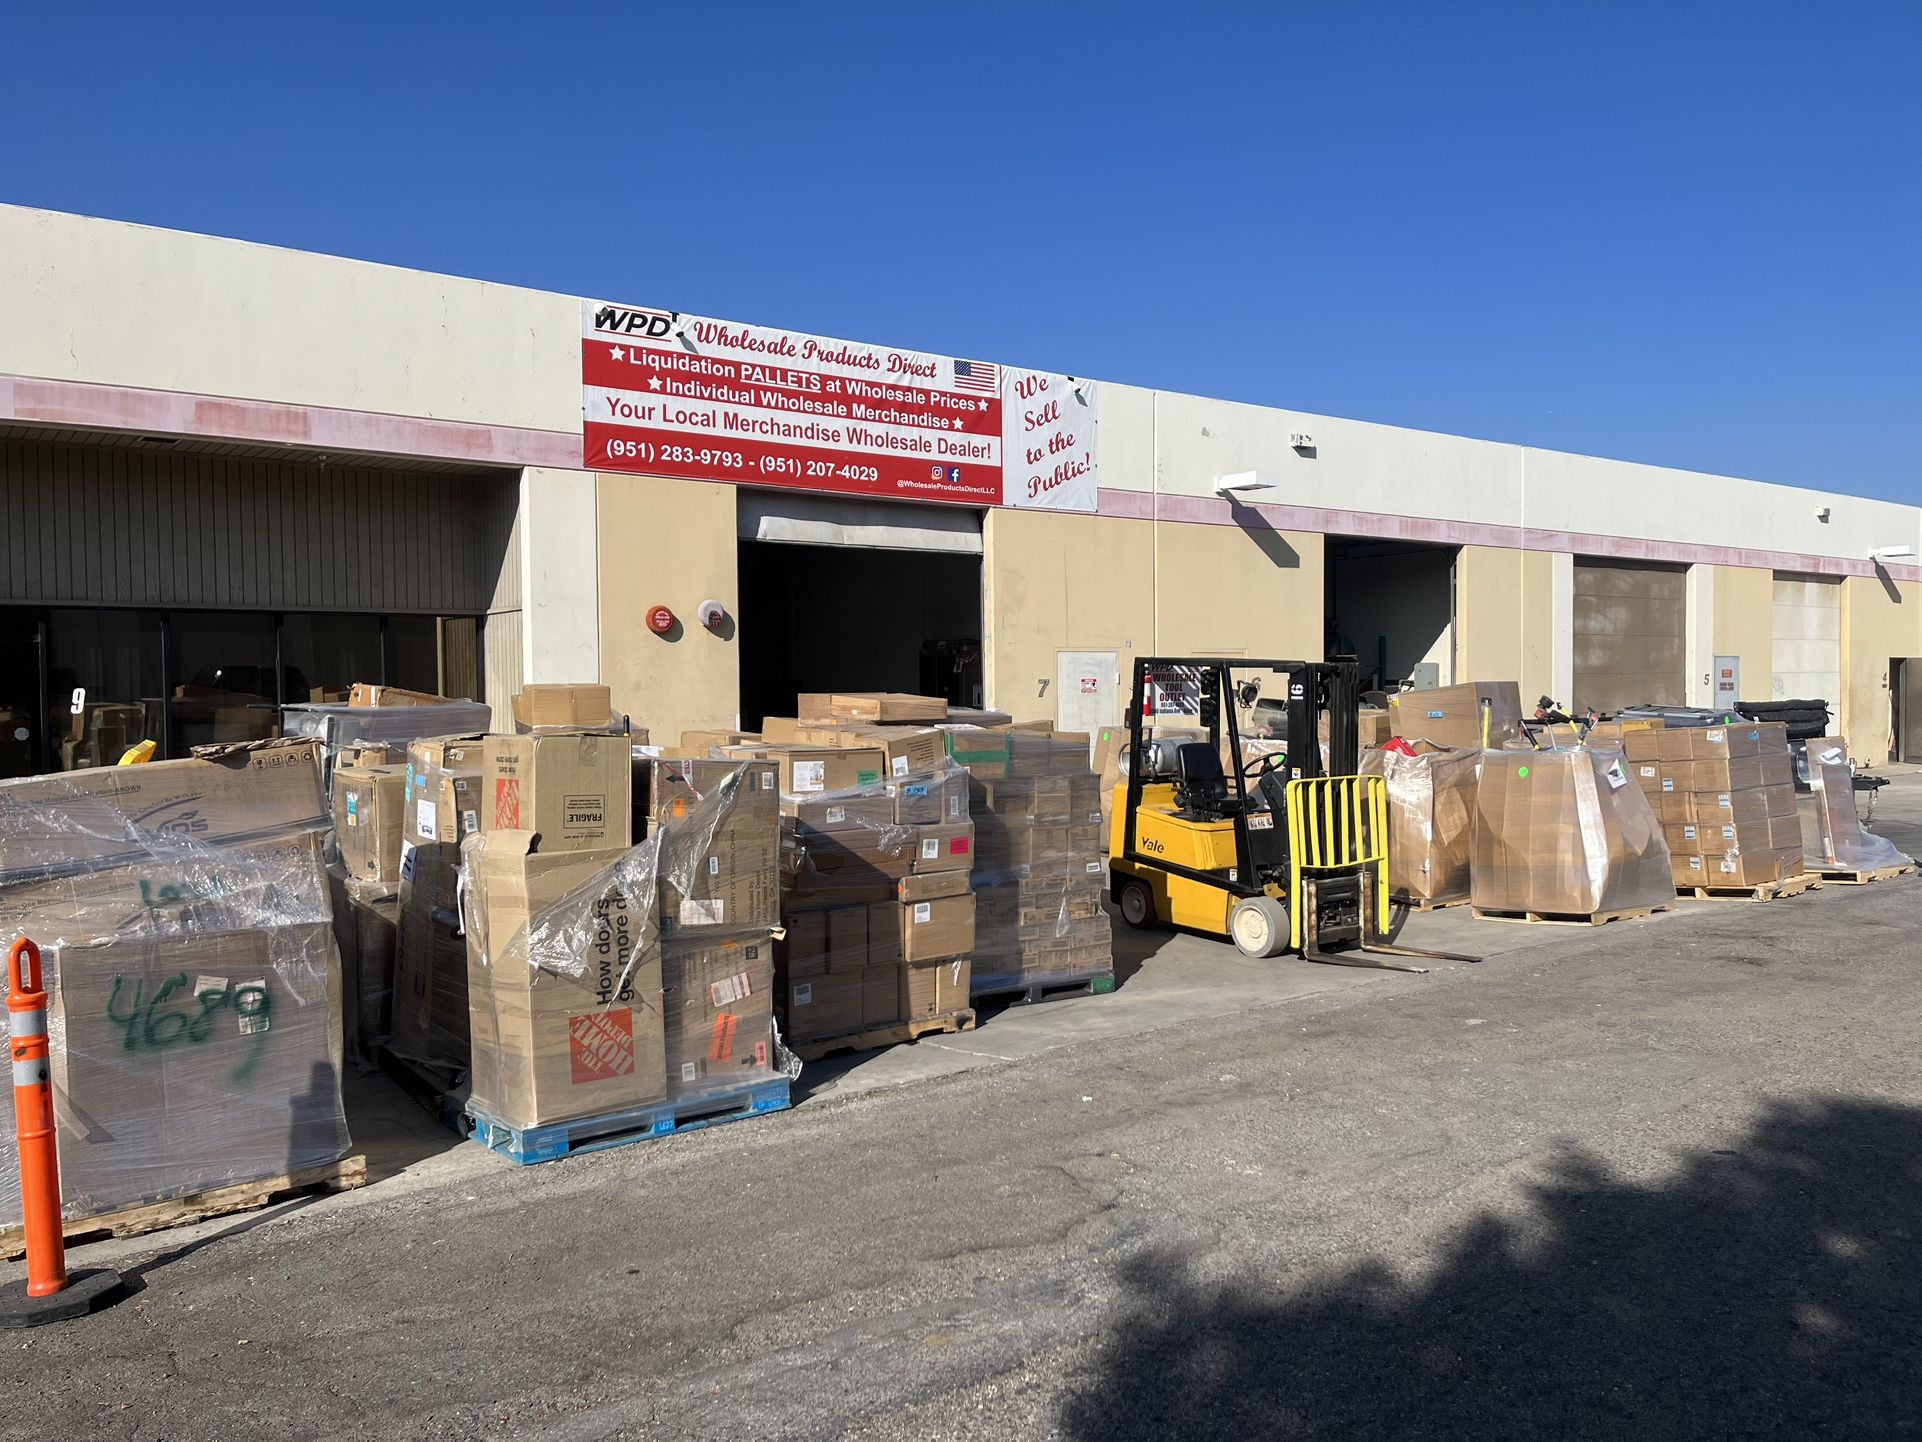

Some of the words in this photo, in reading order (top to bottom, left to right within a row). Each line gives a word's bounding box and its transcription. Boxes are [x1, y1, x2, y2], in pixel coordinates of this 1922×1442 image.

[594, 308, 671, 338] WPD
[693, 321, 797, 358] Wholesale
[801, 339, 881, 370] Products
[887, 353, 937, 379] Direct
[629, 347, 735, 379] Liquidation
[740, 363, 821, 393] PALLETS
[826, 379, 842, 393] at
[845, 381, 926, 405] Wholesale
[930, 390, 976, 411] Prices
[1014, 374, 1049, 400] We
[666, 376, 755, 405] Individual
[760, 390, 847, 417] Wholesale
[852, 402, 949, 429] Merchandise
[1024, 400, 1061, 432] Sell
[606, 396, 656, 421] Your
[662, 403, 717, 428] Local
[723, 411, 841, 443] Merchandise
[846, 426, 932, 452] Wholesale
[937, 437, 991, 459] Dealer!
[606, 438, 655, 463] (951)
[660, 444, 743, 468] 283-9793
[759, 455, 801, 477] (951)
[806, 461, 878, 481] 207-4029
[1026, 445, 1045, 465] to
[1048, 431, 1076, 457] the
[897, 478, 995, 494] @WholesaleProductsDirectLLC
[1027, 452, 1091, 499] Public!
[1037, 678, 1050, 698] 7
[1153, 671, 1196, 682] WHOLESALE
[1164, 683, 1183, 692] TOOL
[1703, 673, 1710, 686] 5
[1882, 671, 1887, 683] 4
[70, 687, 86, 714] 9
[1159, 692, 1186, 702] OUTLET
[568, 813, 603, 823] FRAGILE
[1142, 836, 1165, 853] Yale
[615, 915, 630, 966] more
[596, 960, 612, 1005] How
[616, 970, 634, 1002] get
[570, 1015, 634, 1076] HOME
